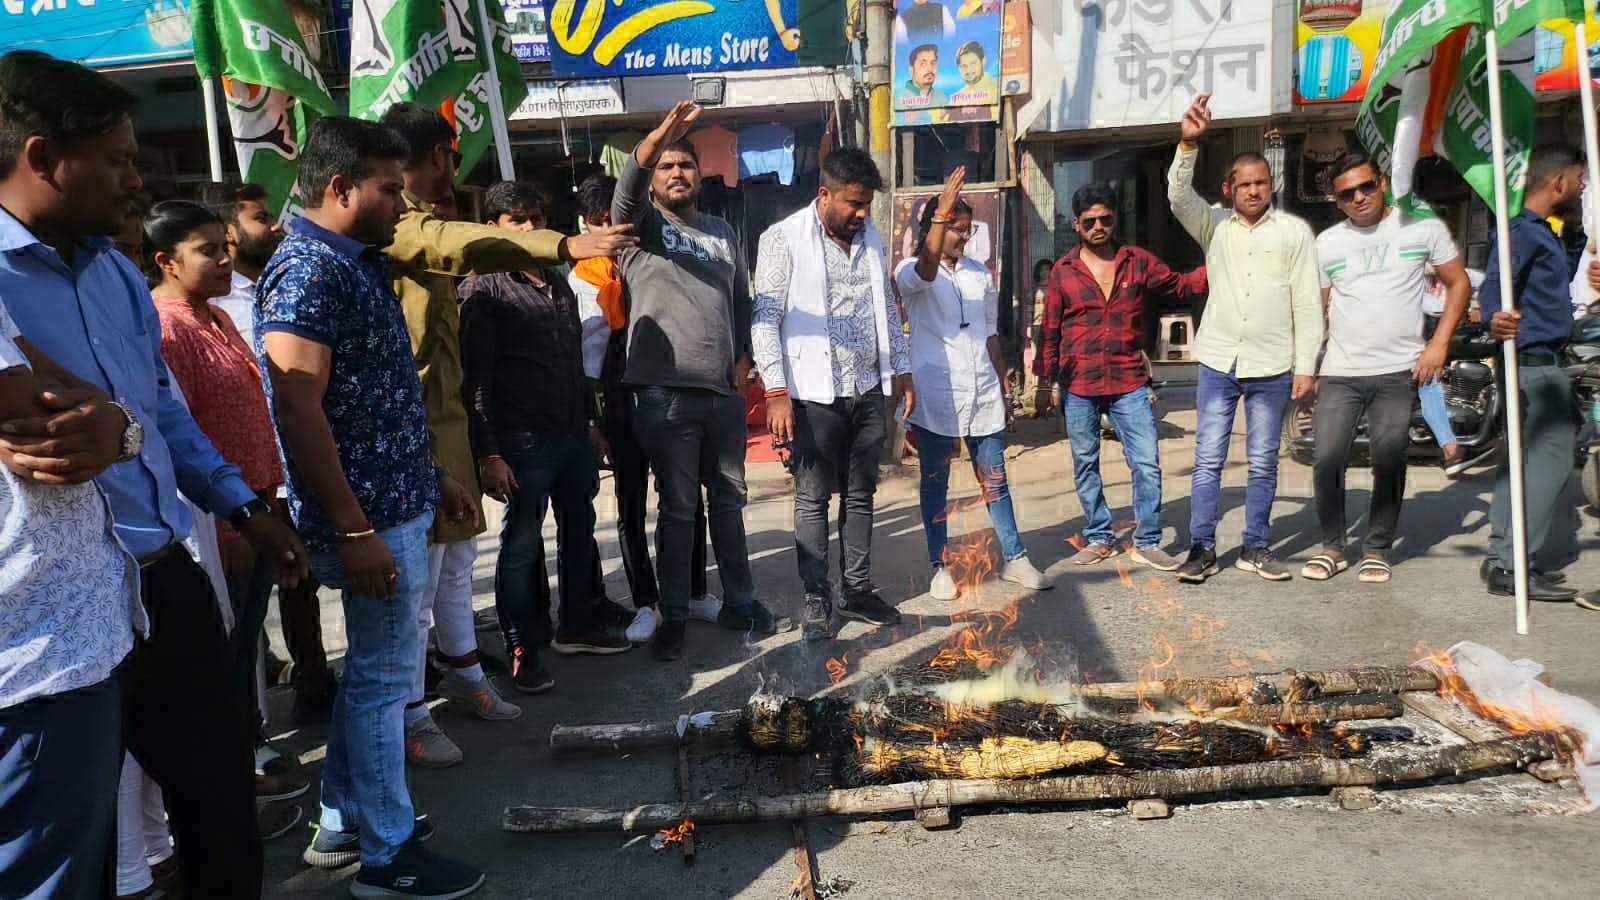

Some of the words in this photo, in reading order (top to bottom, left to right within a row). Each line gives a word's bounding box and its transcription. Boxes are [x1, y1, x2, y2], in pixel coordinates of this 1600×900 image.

[624, 49, 656, 70] The
[663, 42, 713, 68] Mens
[719, 31, 770, 65] Store
[1113, 32, 1266, 101] फैशन
